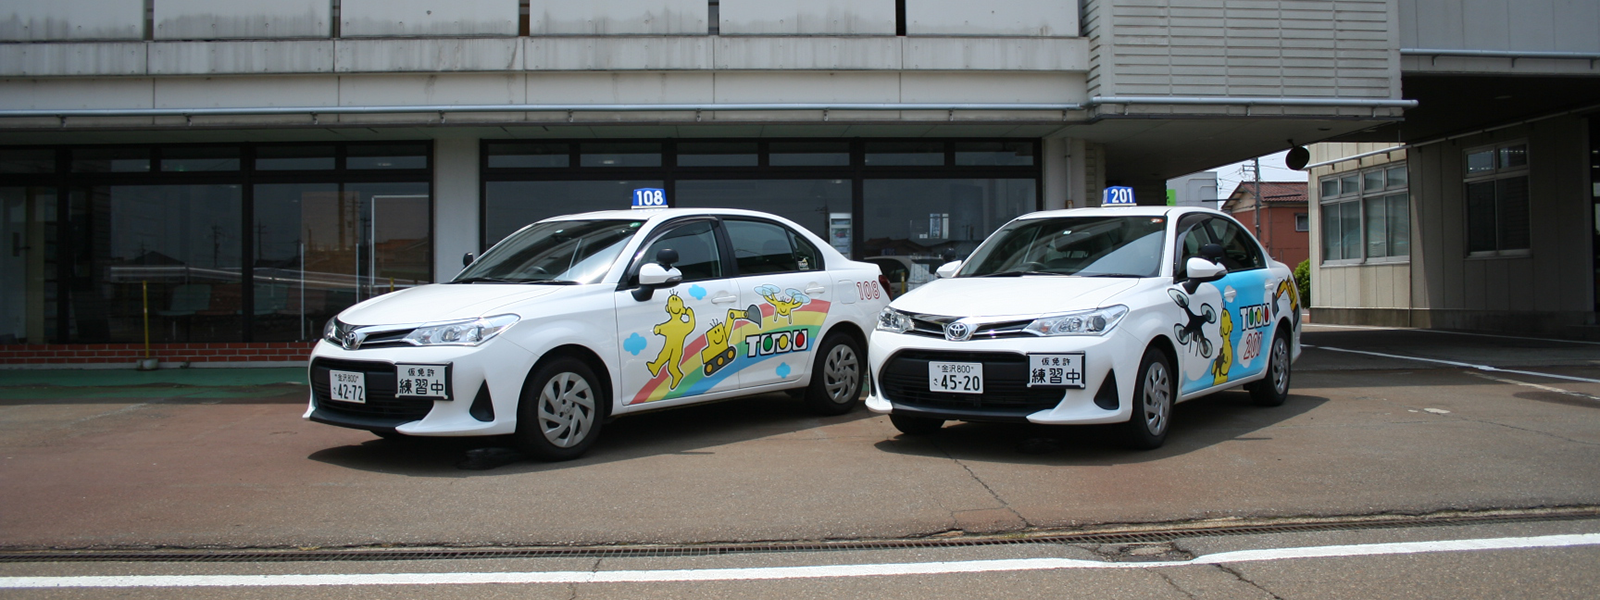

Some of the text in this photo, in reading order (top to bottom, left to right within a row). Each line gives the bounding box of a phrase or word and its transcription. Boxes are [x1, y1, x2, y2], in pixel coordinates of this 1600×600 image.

[636, 190, 664, 206] 108
[1111, 188, 1133, 204] 201
[856, 280, 880, 300] 108
[745, 328, 809, 358] TOBU
[1243, 331, 1263, 360] 201
[1041, 357, 1071, 366] 仮免許
[407, 367, 435, 377] 仮免許
[1031, 368, 1081, 384] 練習中
[399, 378, 444, 395] 練習中
[940, 374, 980, 391] 45-20
[338, 383, 364, 401] 42-72
